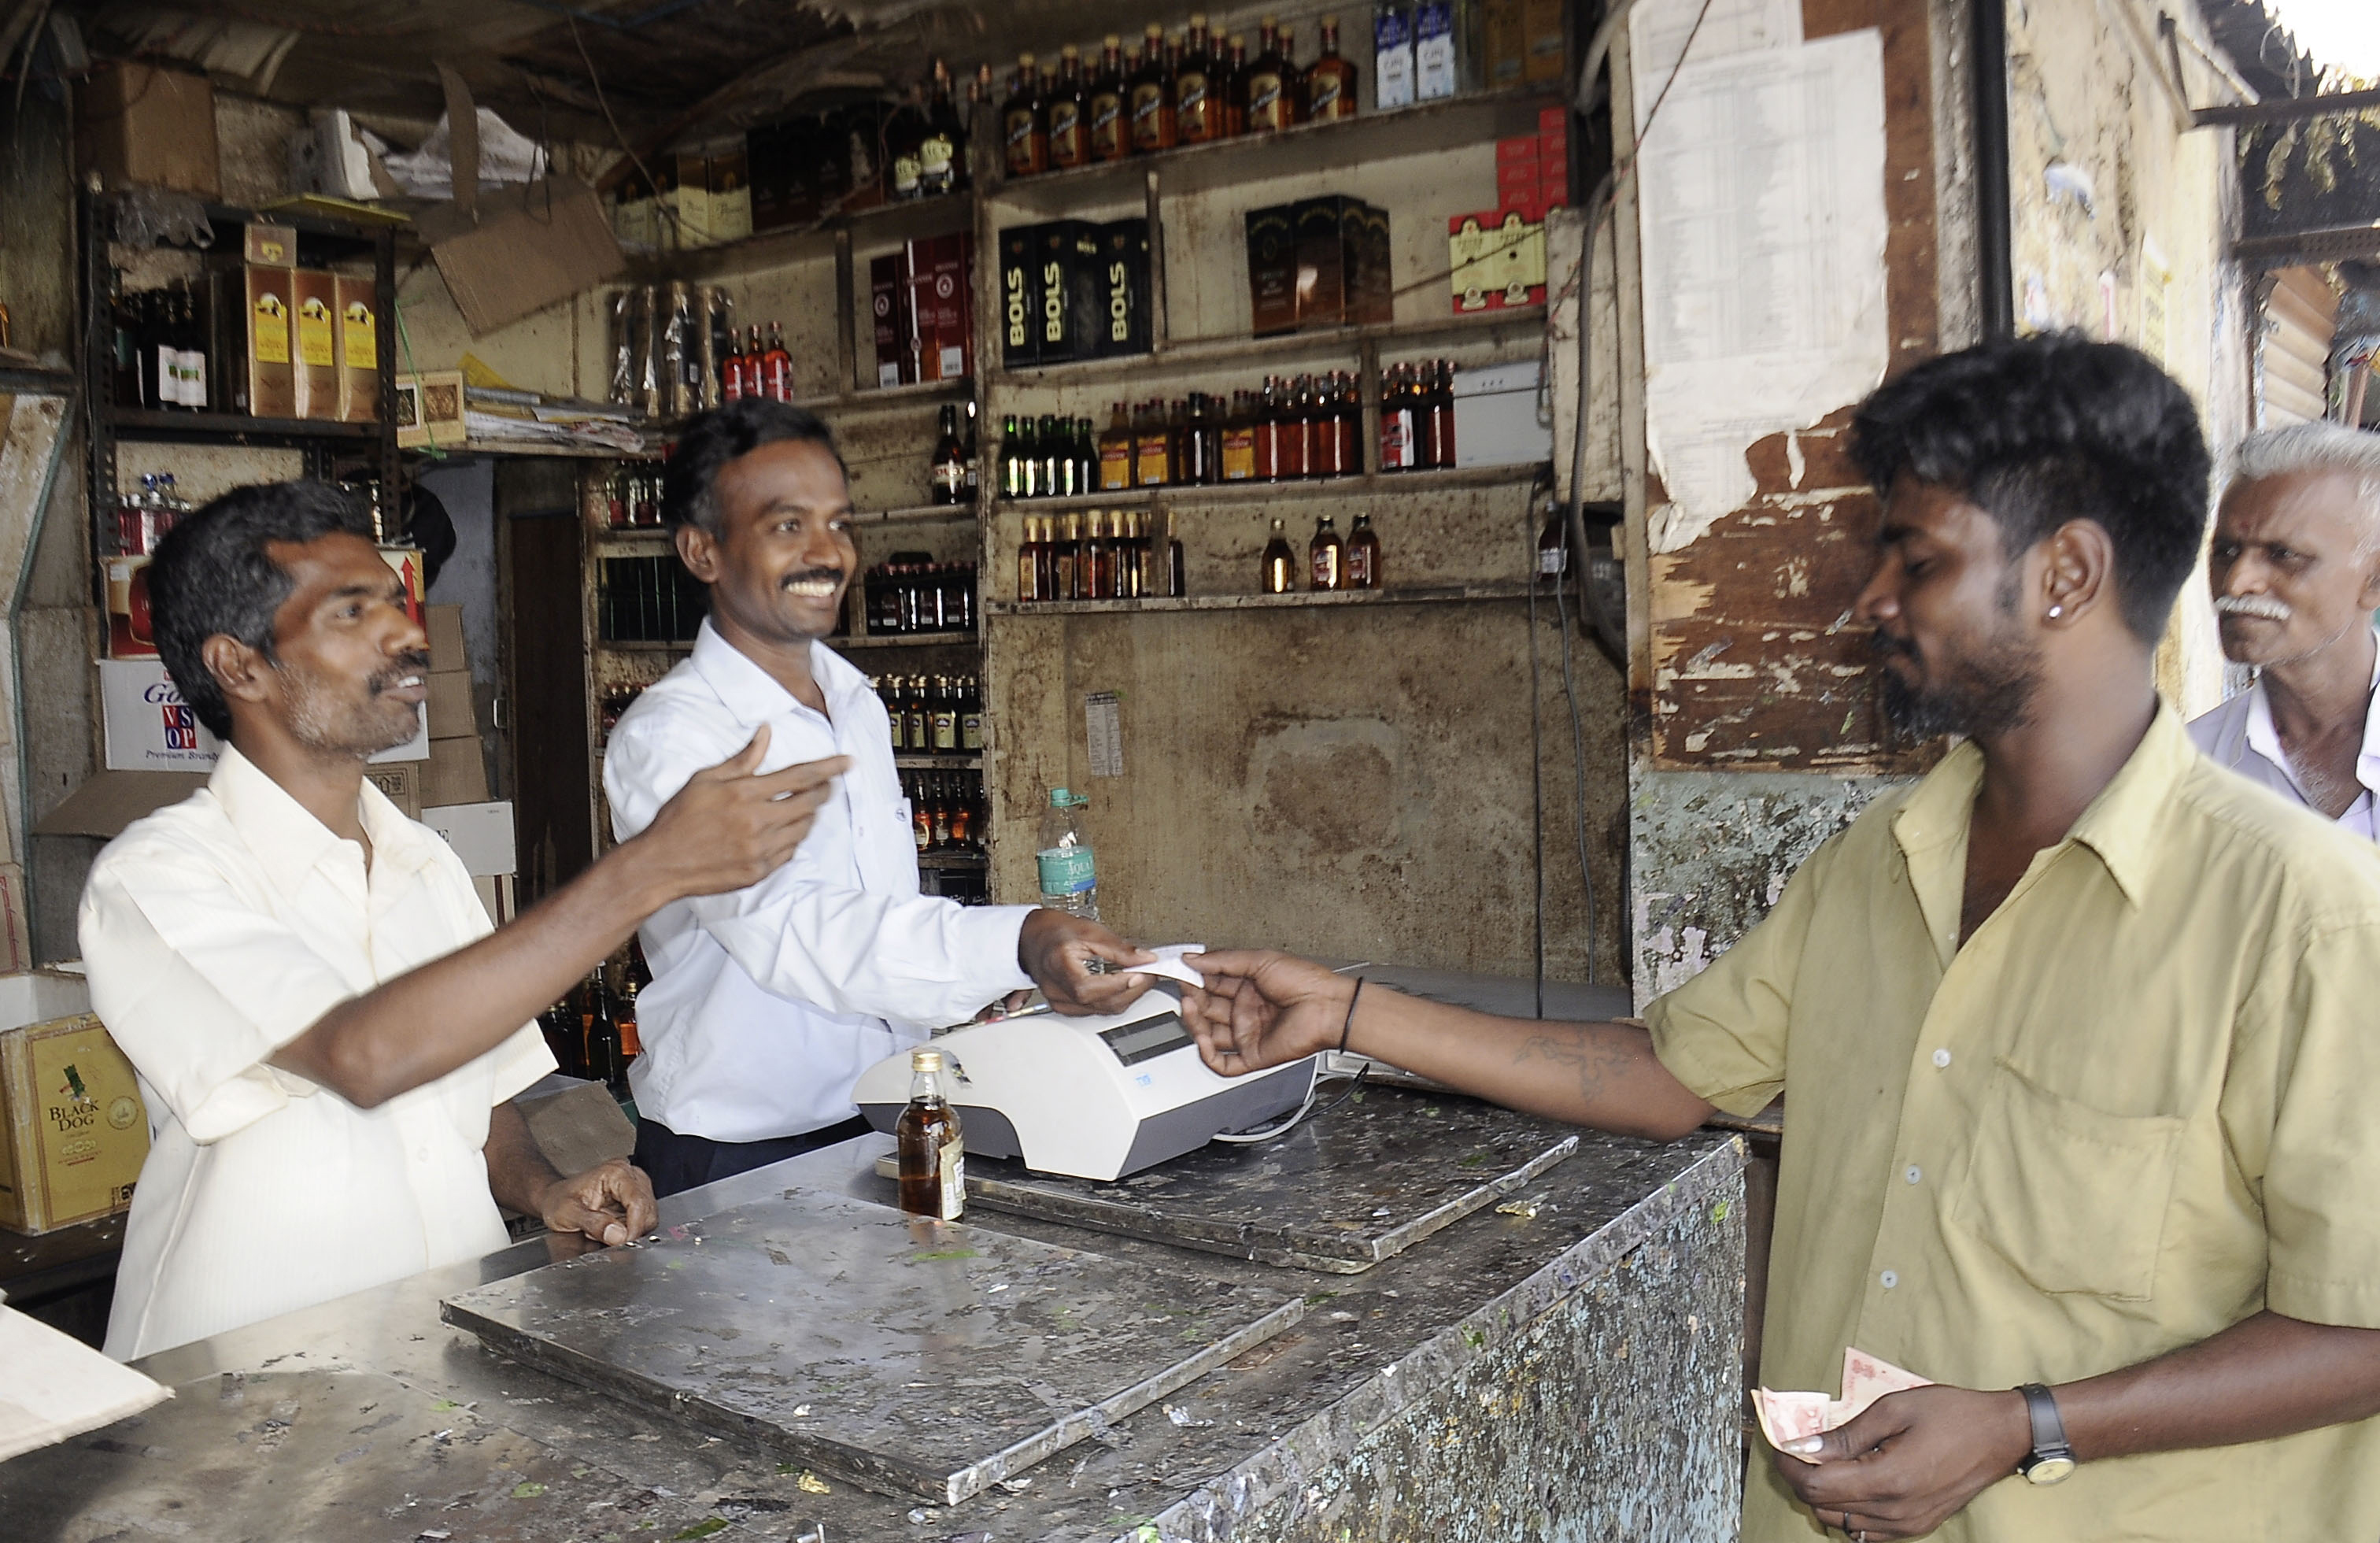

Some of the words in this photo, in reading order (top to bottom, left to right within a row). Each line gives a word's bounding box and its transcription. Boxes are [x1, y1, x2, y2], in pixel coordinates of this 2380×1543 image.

[1007, 267, 1025, 346] BOLS
[1044, 261, 1062, 342] BOLS
[1110, 261, 1127, 342] BOLS
[144, 683, 185, 704] Go
[50, 1100, 99, 1121] BLACK
[59, 1113, 94, 1131] DOG
